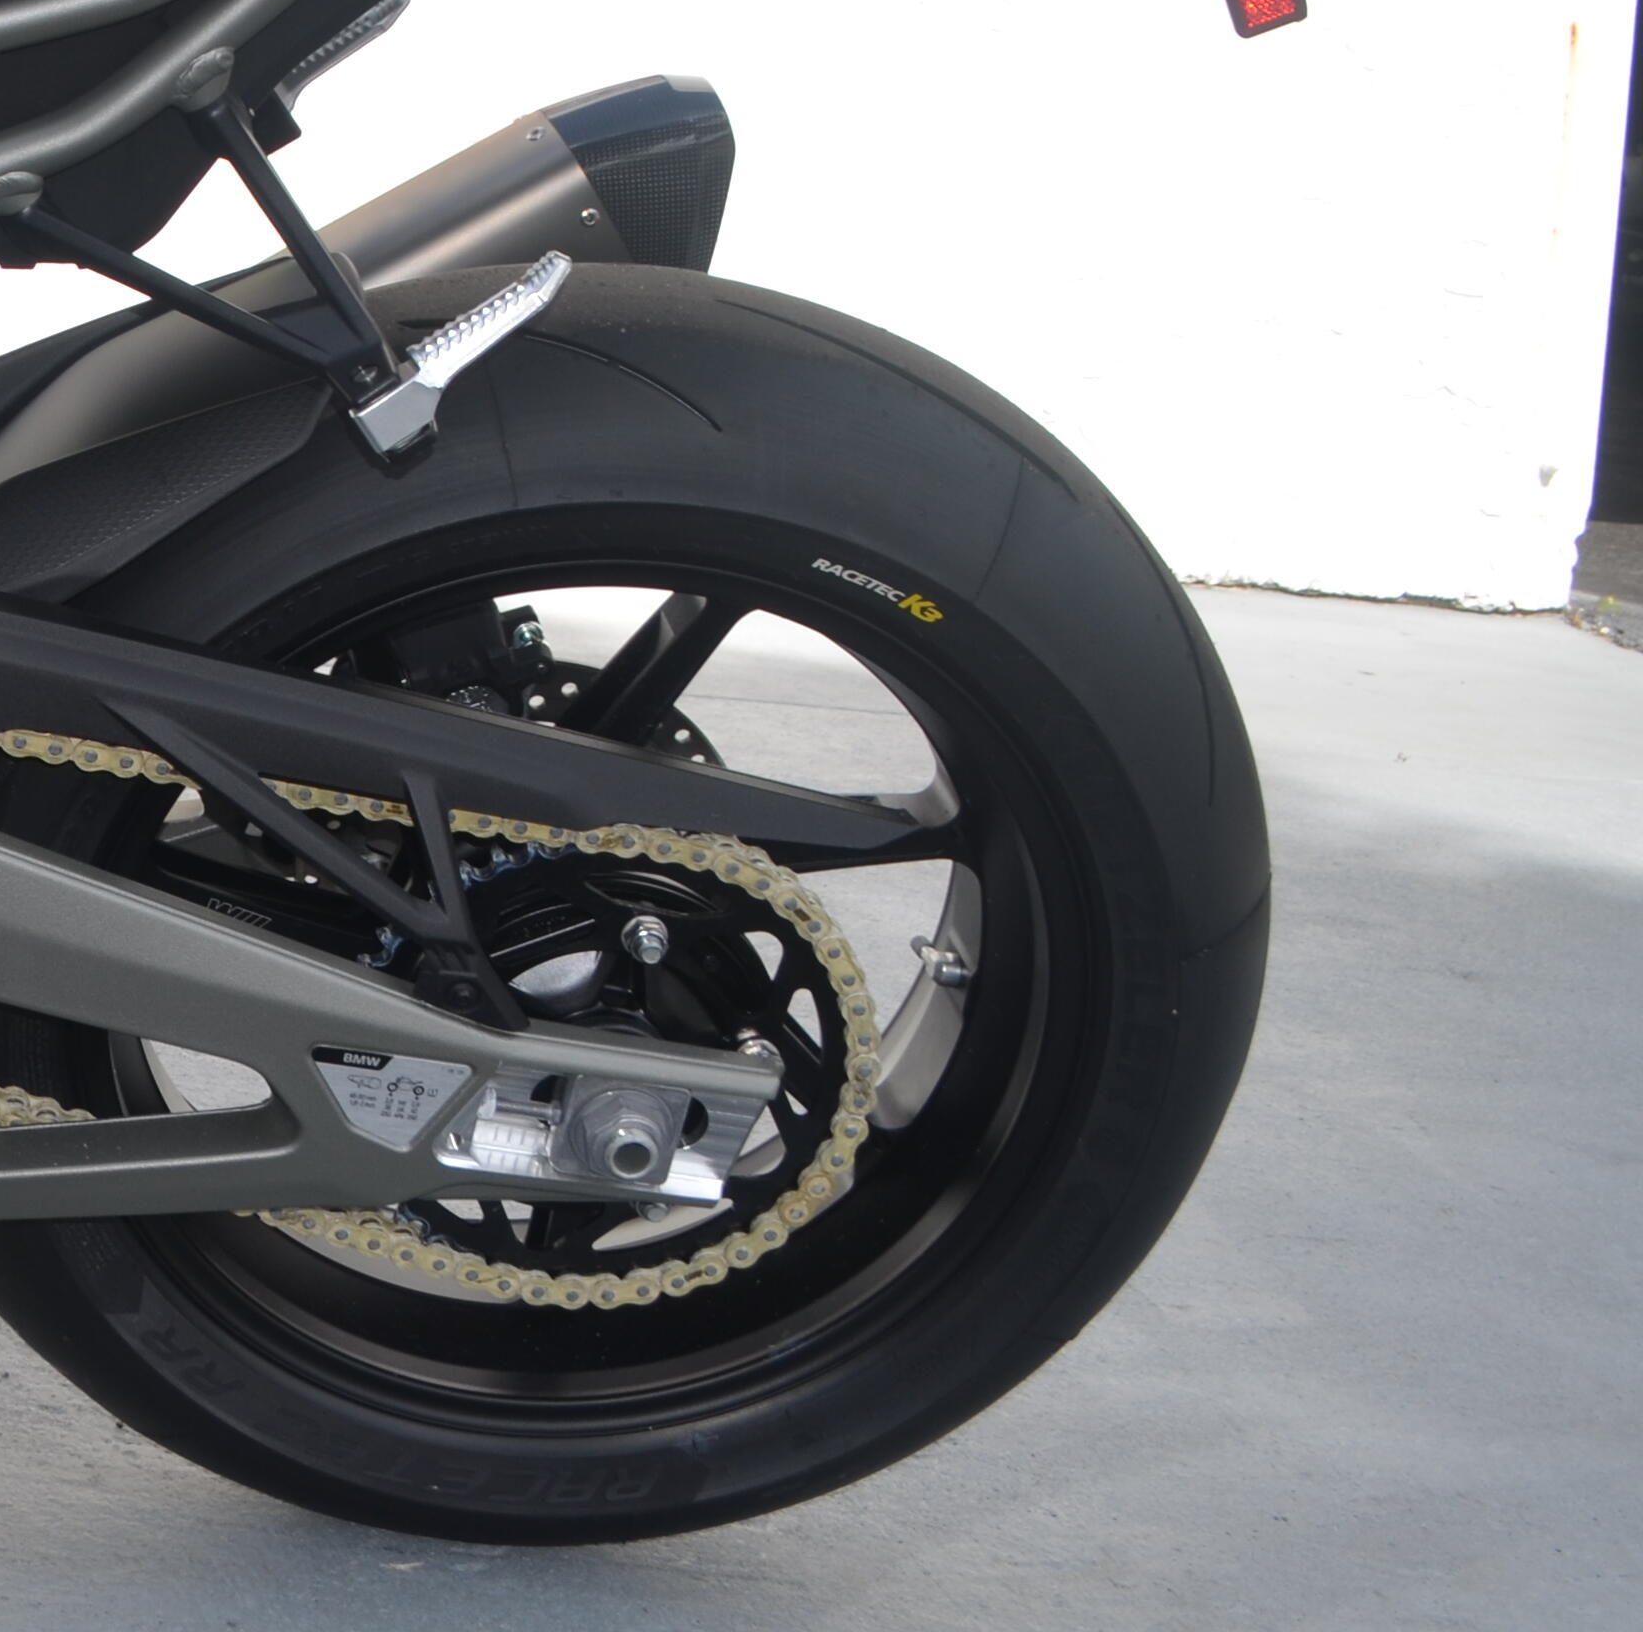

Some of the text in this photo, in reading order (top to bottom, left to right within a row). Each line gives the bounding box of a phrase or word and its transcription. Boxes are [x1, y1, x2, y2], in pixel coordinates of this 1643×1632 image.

[811, 557, 945, 623] RACETEC K3
[342, 1052, 382, 1067] BMW
